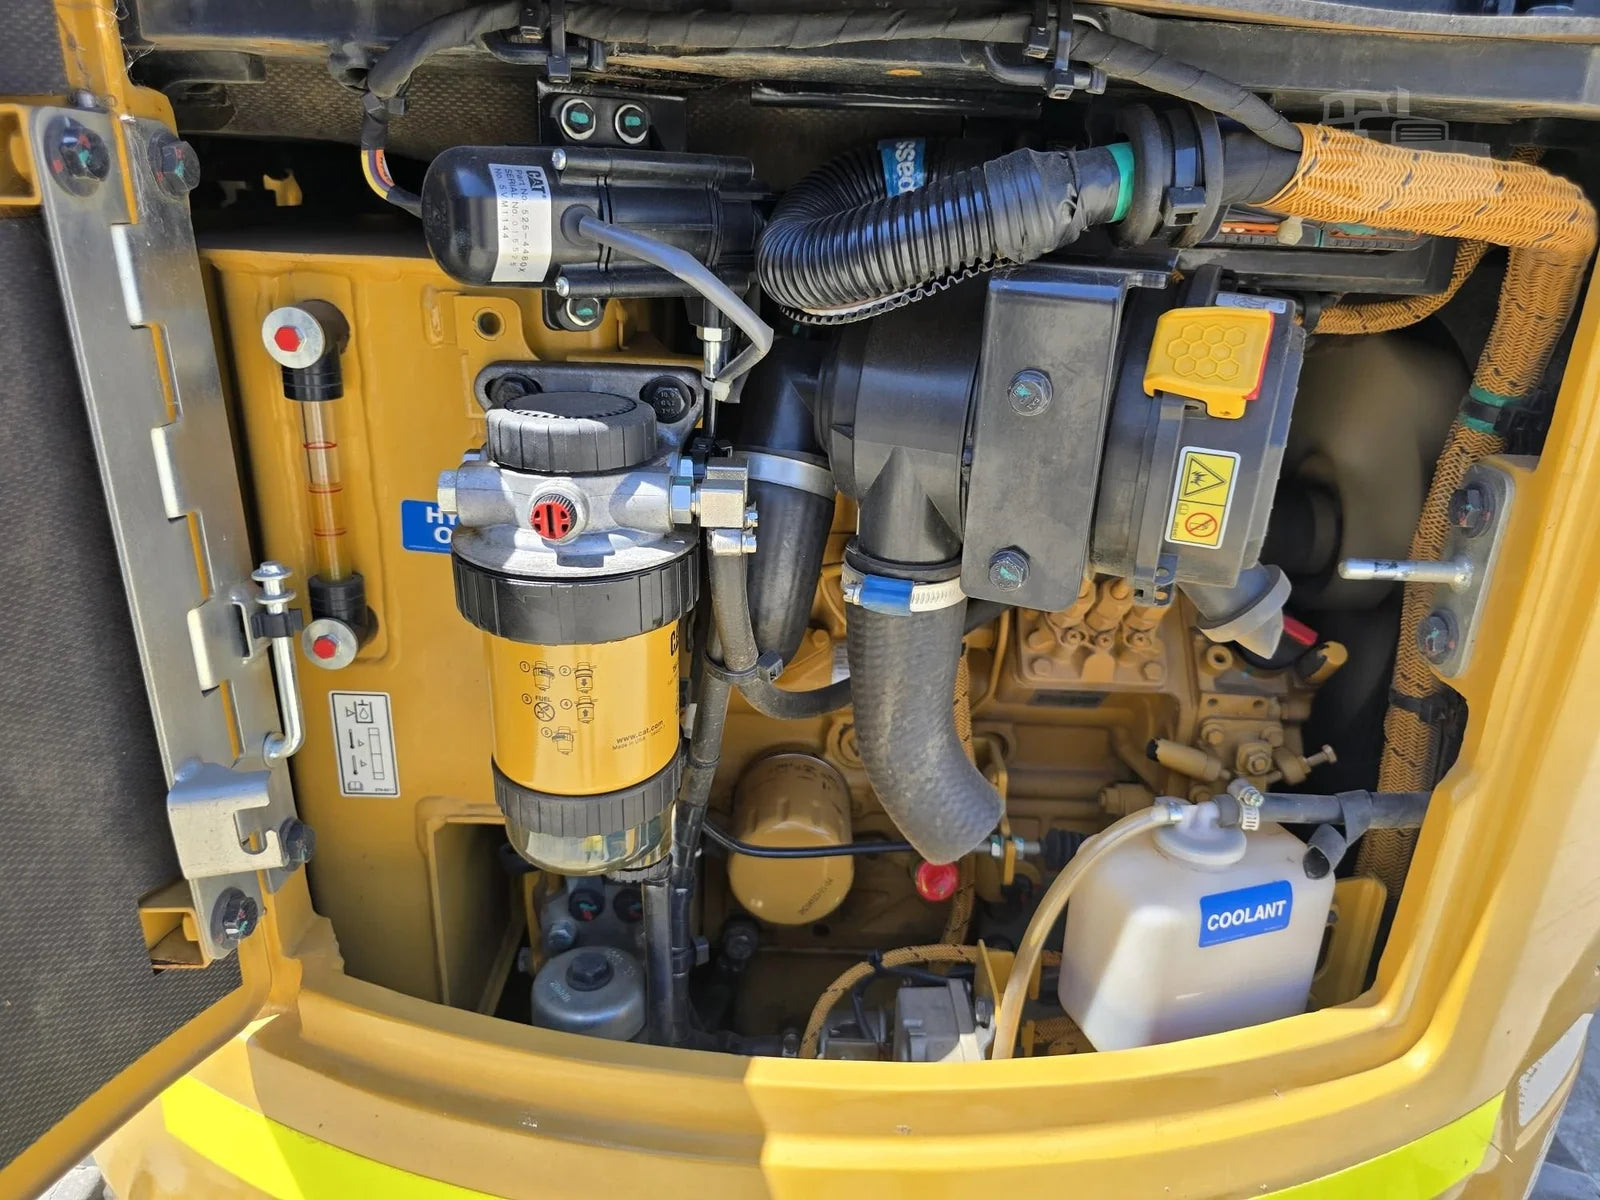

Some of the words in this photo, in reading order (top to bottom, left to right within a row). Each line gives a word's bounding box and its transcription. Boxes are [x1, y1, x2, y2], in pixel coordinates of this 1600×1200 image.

[505, 169, 516, 198] SERIAL
[511, 202, 519, 217] No.
[514, 169, 525, 188] Part
[520, 188, 529, 204] No.
[526, 169, 546, 192] CAT
[616, 720, 664, 744] www.cat.com
[1207, 900, 1287, 931] COOLANT
